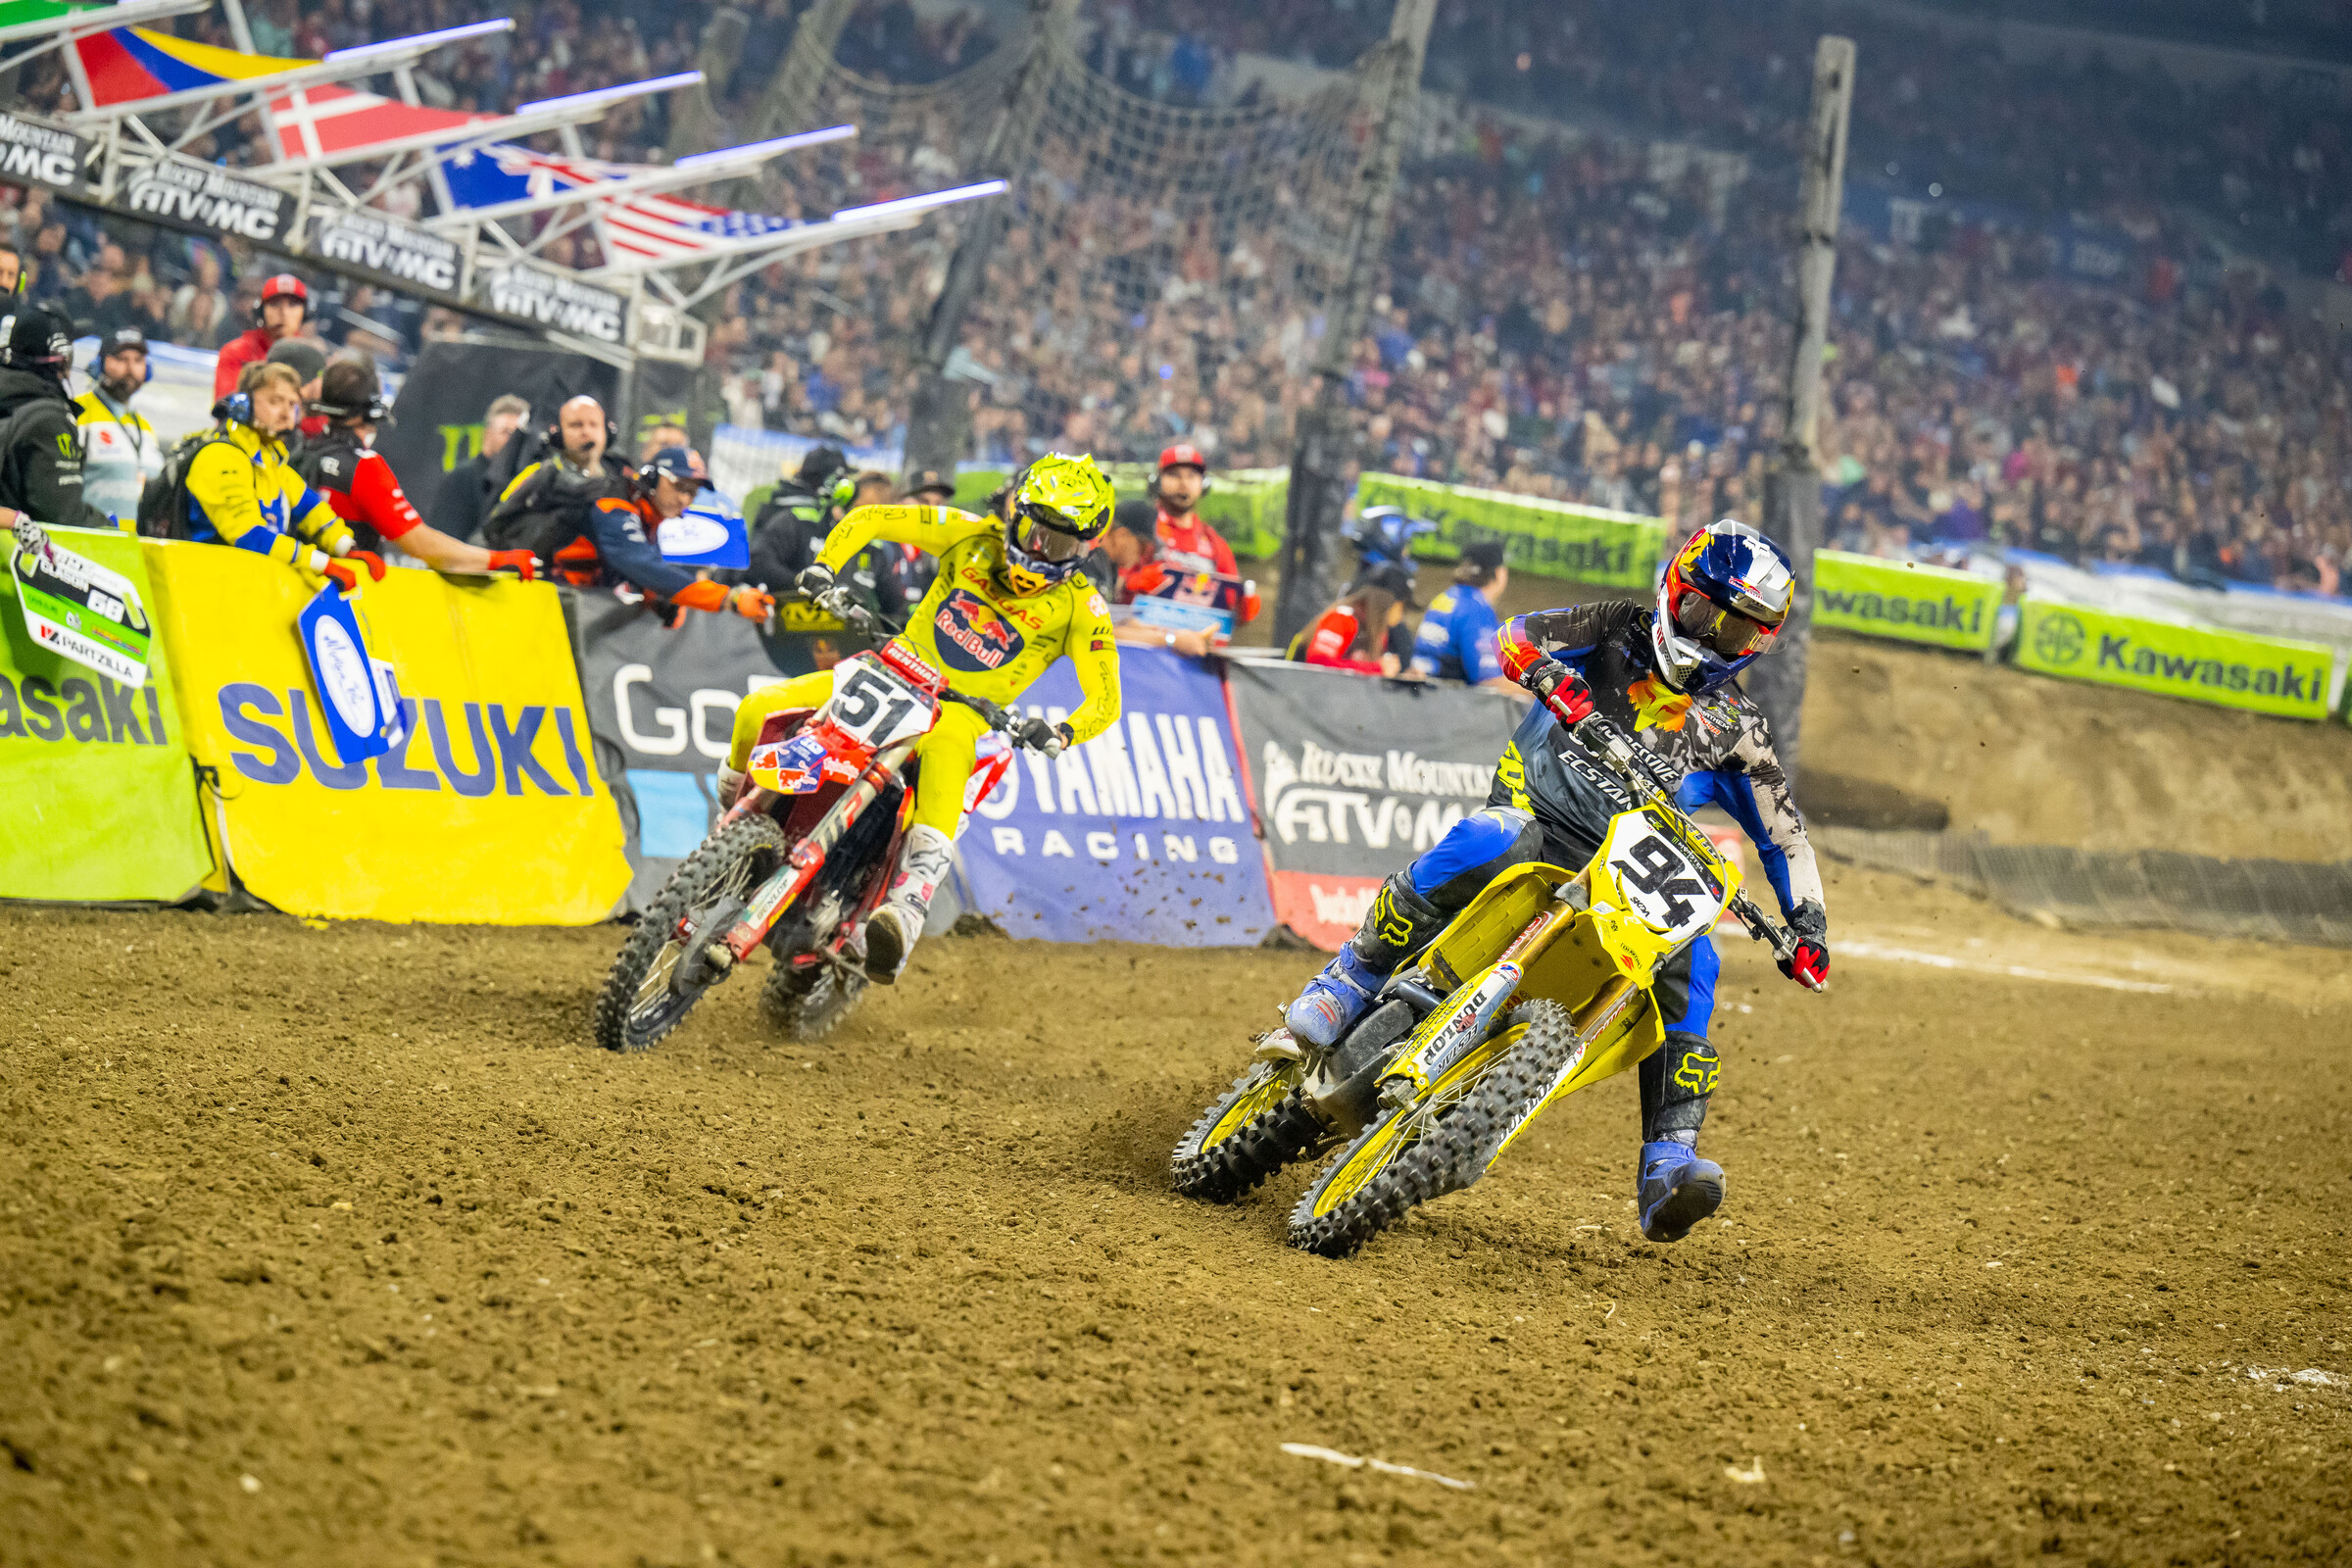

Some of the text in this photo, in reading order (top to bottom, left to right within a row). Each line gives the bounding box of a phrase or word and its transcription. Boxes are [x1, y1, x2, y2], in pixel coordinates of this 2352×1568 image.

[86, 589, 124, 623] 68
[961, 567, 1045, 630] GASGAS
[62, 635, 133, 679] PARTZILLA
[935, 608, 974, 648] Red
[964, 631, 1005, 670] Bull
[2098, 633, 2323, 704] Kawasaki
[613, 663, 786, 760] Go
[831, 668, 915, 747] 51
[218, 682, 595, 798] SUZUKI
[1005, 704, 1246, 823] YAMAHA
[1301, 740, 1384, 789] ROCKY
[991, 826, 1240, 865] RACING
[1413, 800, 1487, 852] M
[1609, 835, 1706, 929] 94
[1423, 990, 1488, 1066] DUNLOP
[1434, 1021, 1480, 1076] ECSTAR
